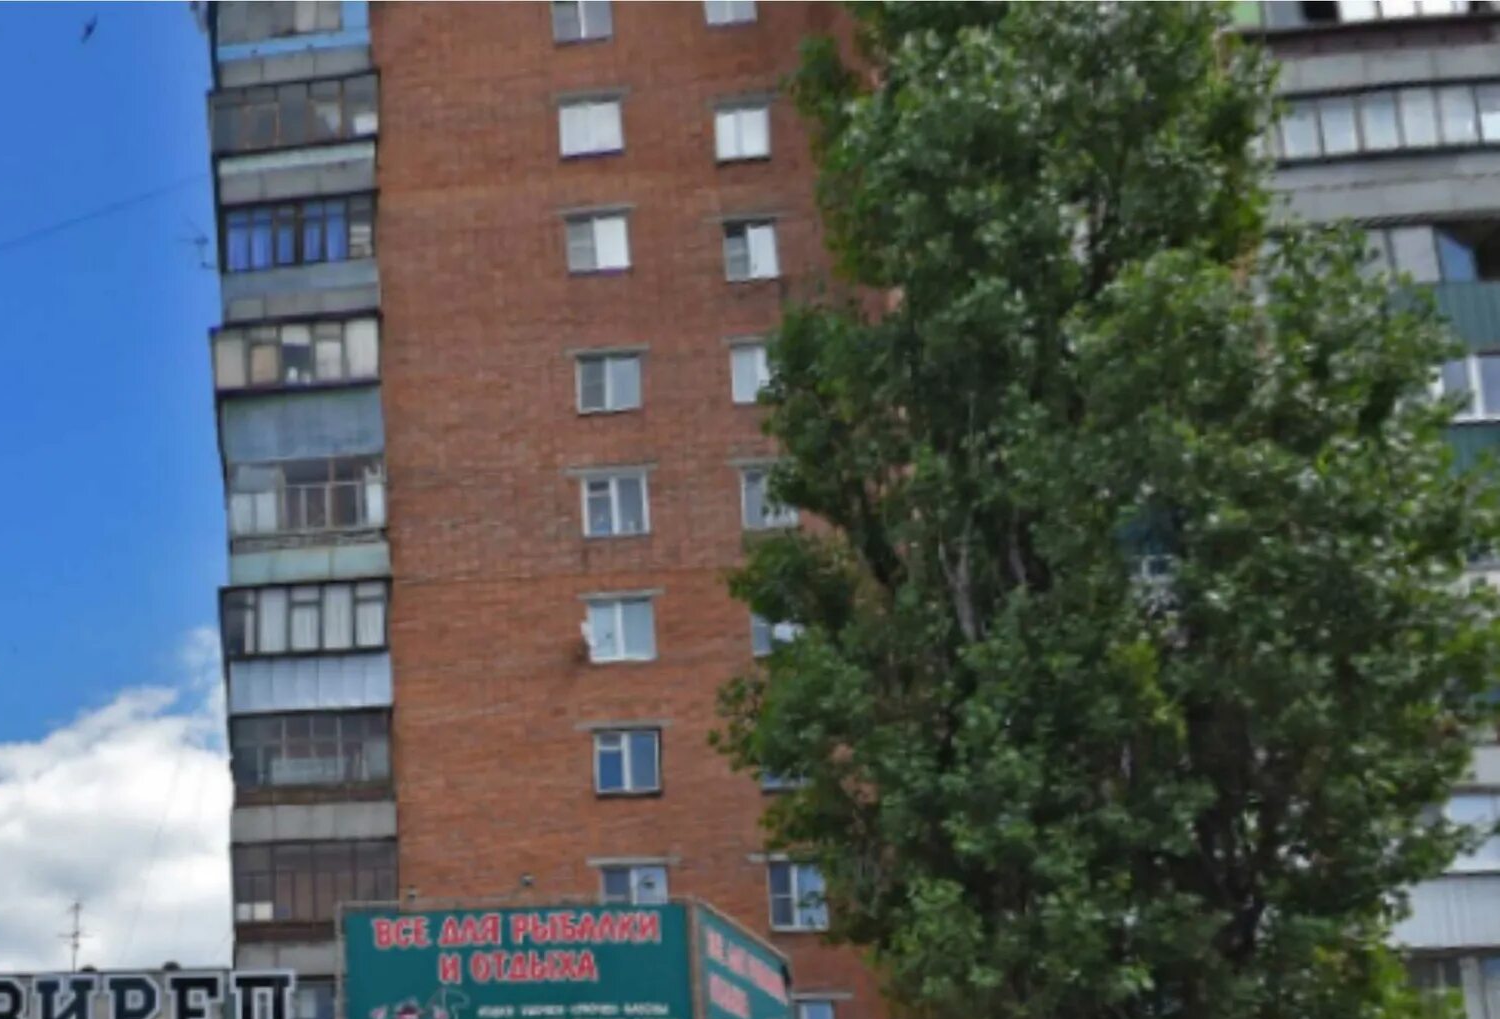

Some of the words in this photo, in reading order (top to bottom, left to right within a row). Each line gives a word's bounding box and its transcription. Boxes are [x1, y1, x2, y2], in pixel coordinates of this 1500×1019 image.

[372, 915, 430, 950] ВСЕ
[438, 913, 501, 947] ДЛЯ
[510, 910, 662, 946] РЫБАЛКИ
[438, 952, 463, 984] И
[469, 949, 599, 983] ОТДЫХА
